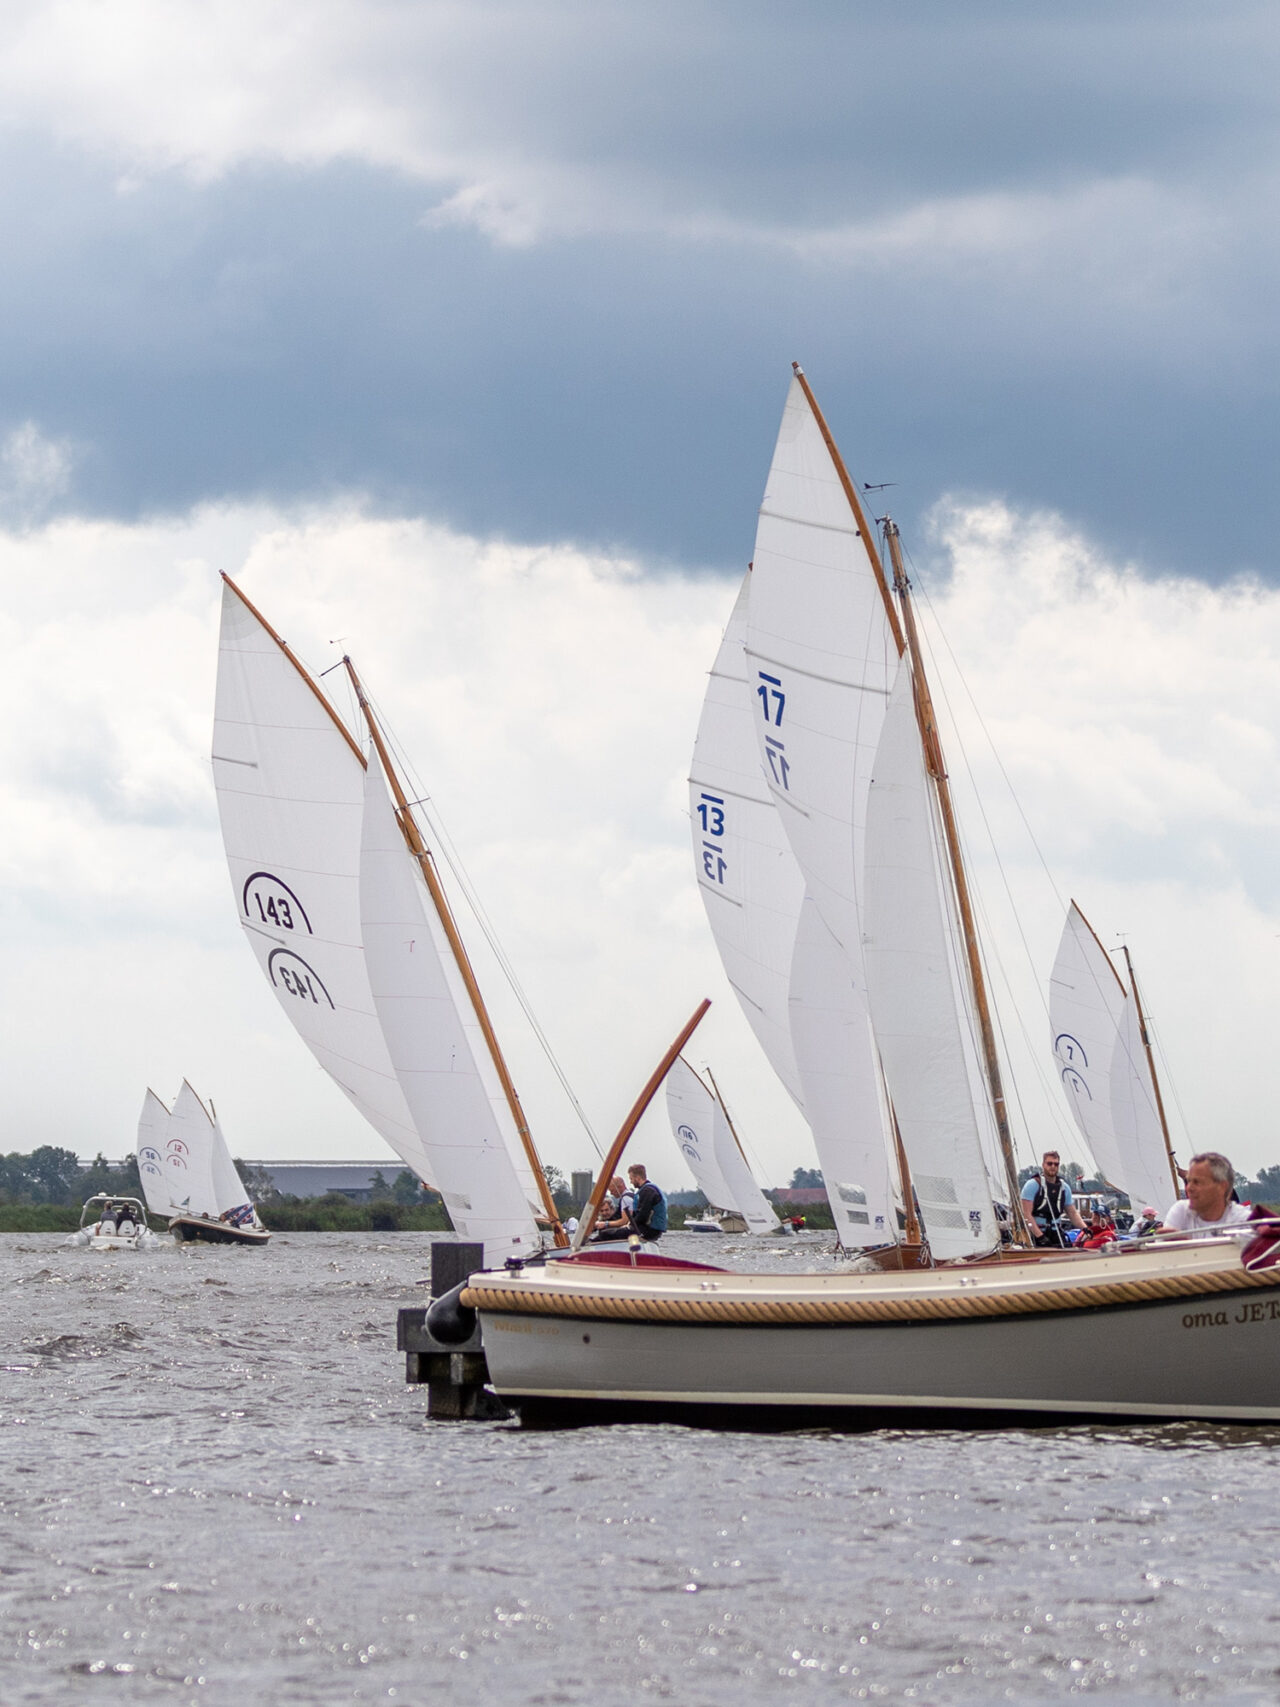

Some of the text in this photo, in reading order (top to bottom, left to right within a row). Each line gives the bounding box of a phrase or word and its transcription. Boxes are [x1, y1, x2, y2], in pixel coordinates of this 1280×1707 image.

[757, 684, 786, 727] 17
[696, 803, 725, 837] 13
[254, 892, 294, 929] 143
[1066, 1045, 1073, 1060] 7
[1182, 1310, 1229, 1328] oma
